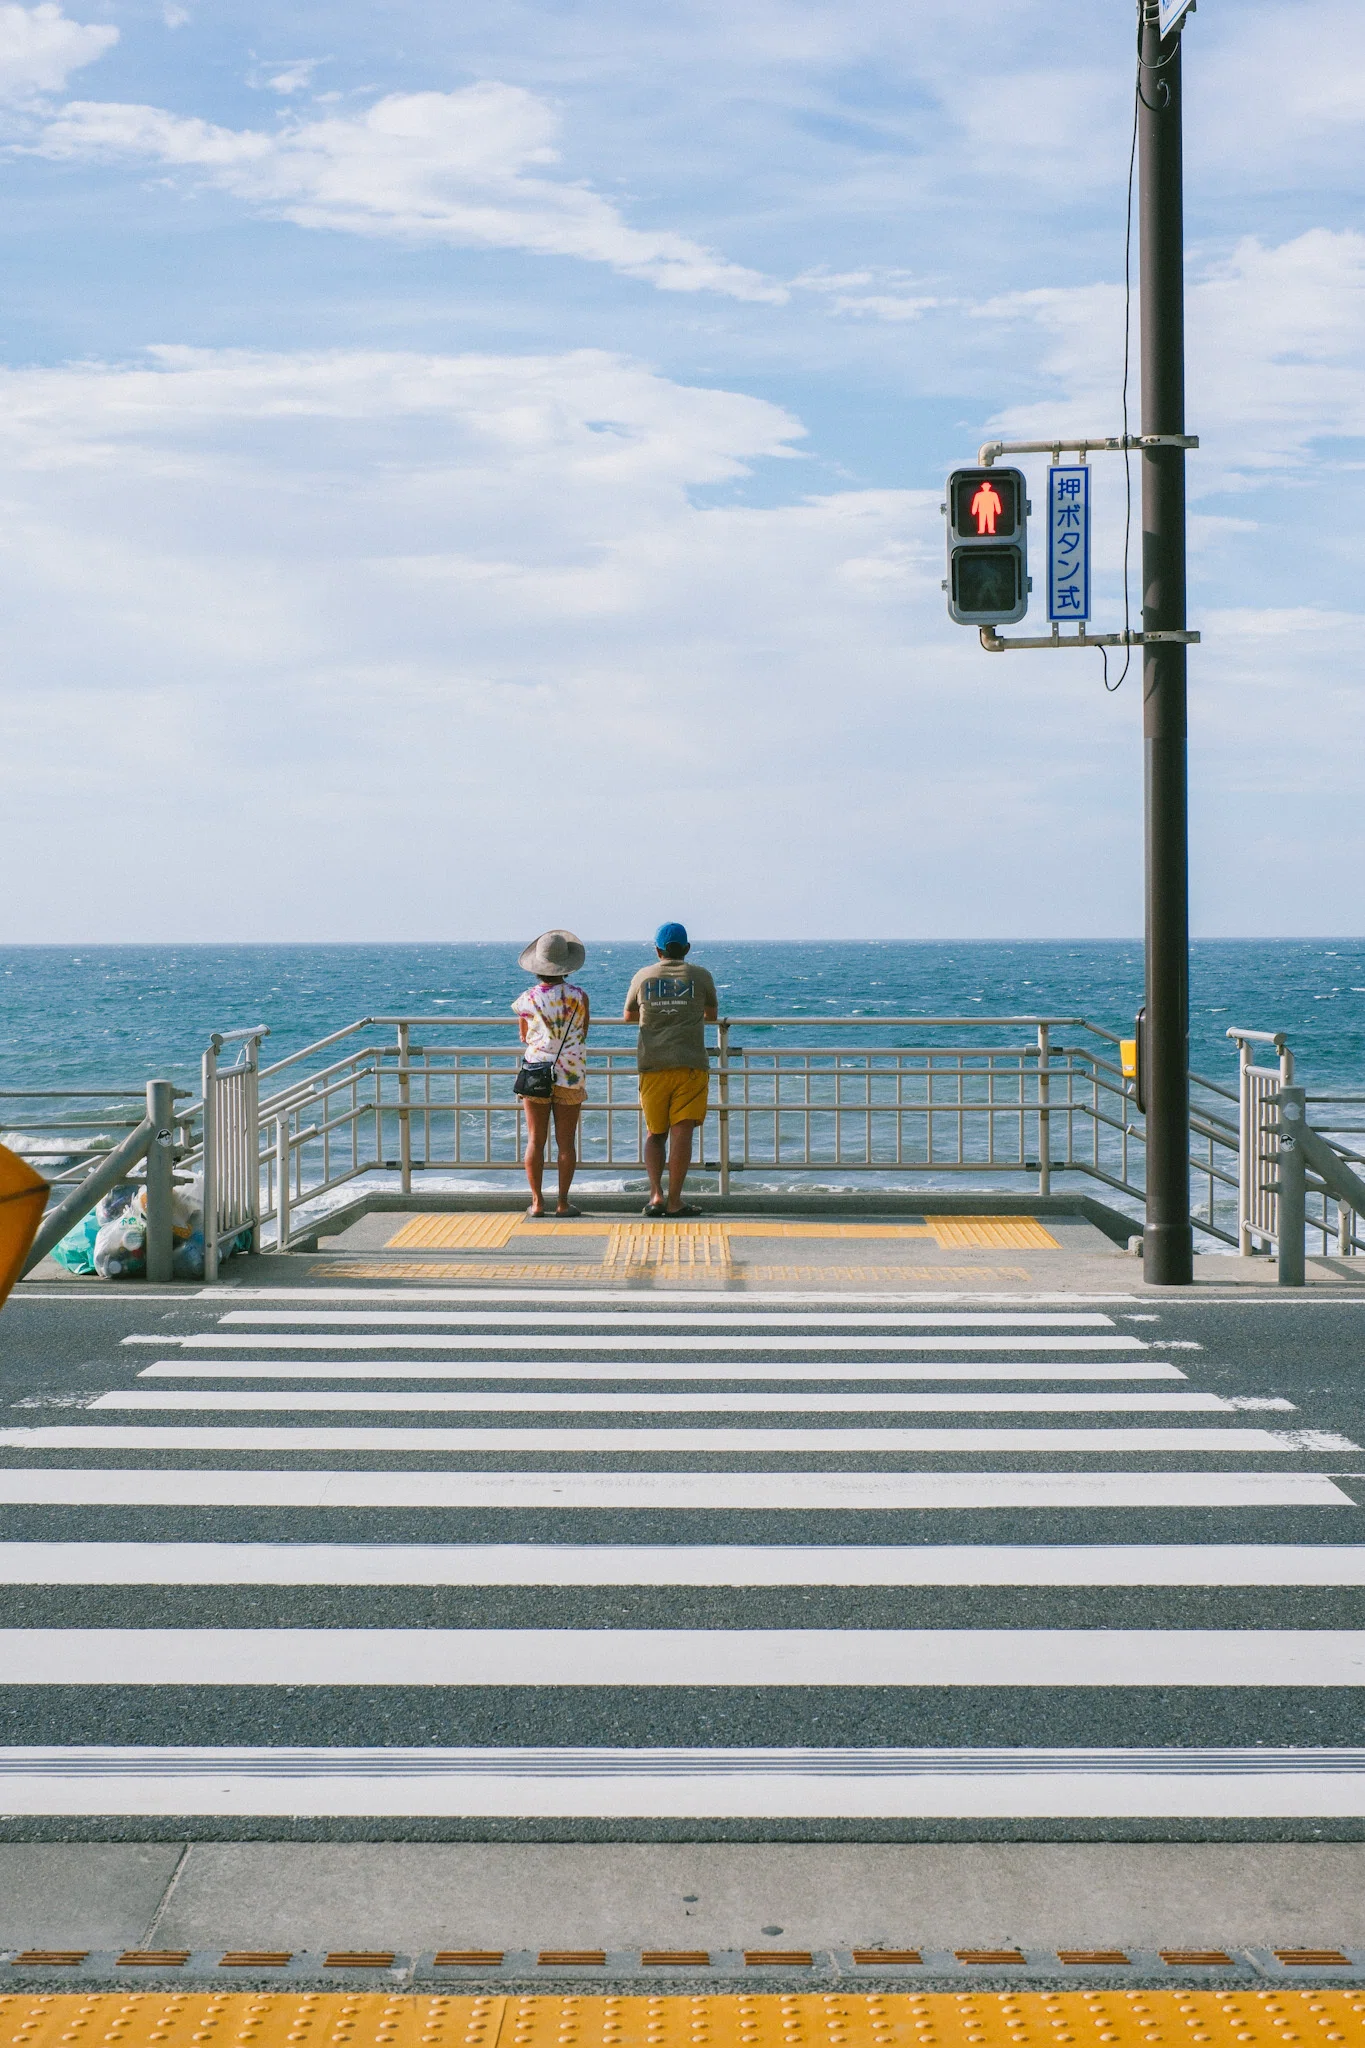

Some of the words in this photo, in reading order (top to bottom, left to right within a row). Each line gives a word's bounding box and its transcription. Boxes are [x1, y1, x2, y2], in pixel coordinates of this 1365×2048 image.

[1057, 477, 1081, 610] 押ボタン式
